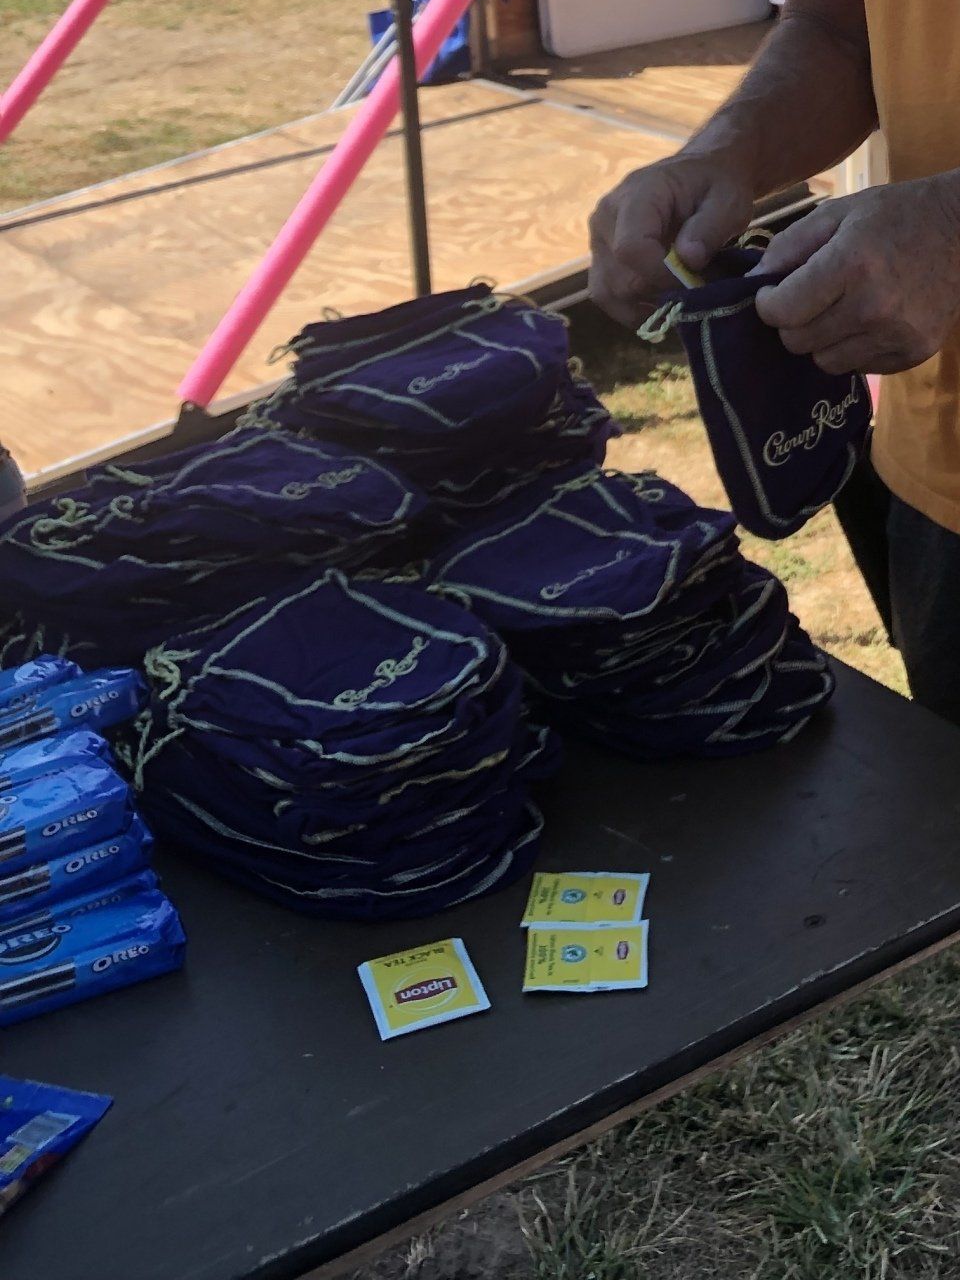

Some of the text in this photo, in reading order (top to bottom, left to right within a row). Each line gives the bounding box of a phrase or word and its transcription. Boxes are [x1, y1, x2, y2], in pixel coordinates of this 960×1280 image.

[763, 375, 859, 467] Crown Royal
[42, 809, 98, 837] OREO
[65, 845, 120, 873] OREO
[92, 944, 150, 972] OREO
[400, 979, 452, 999] Lipton
